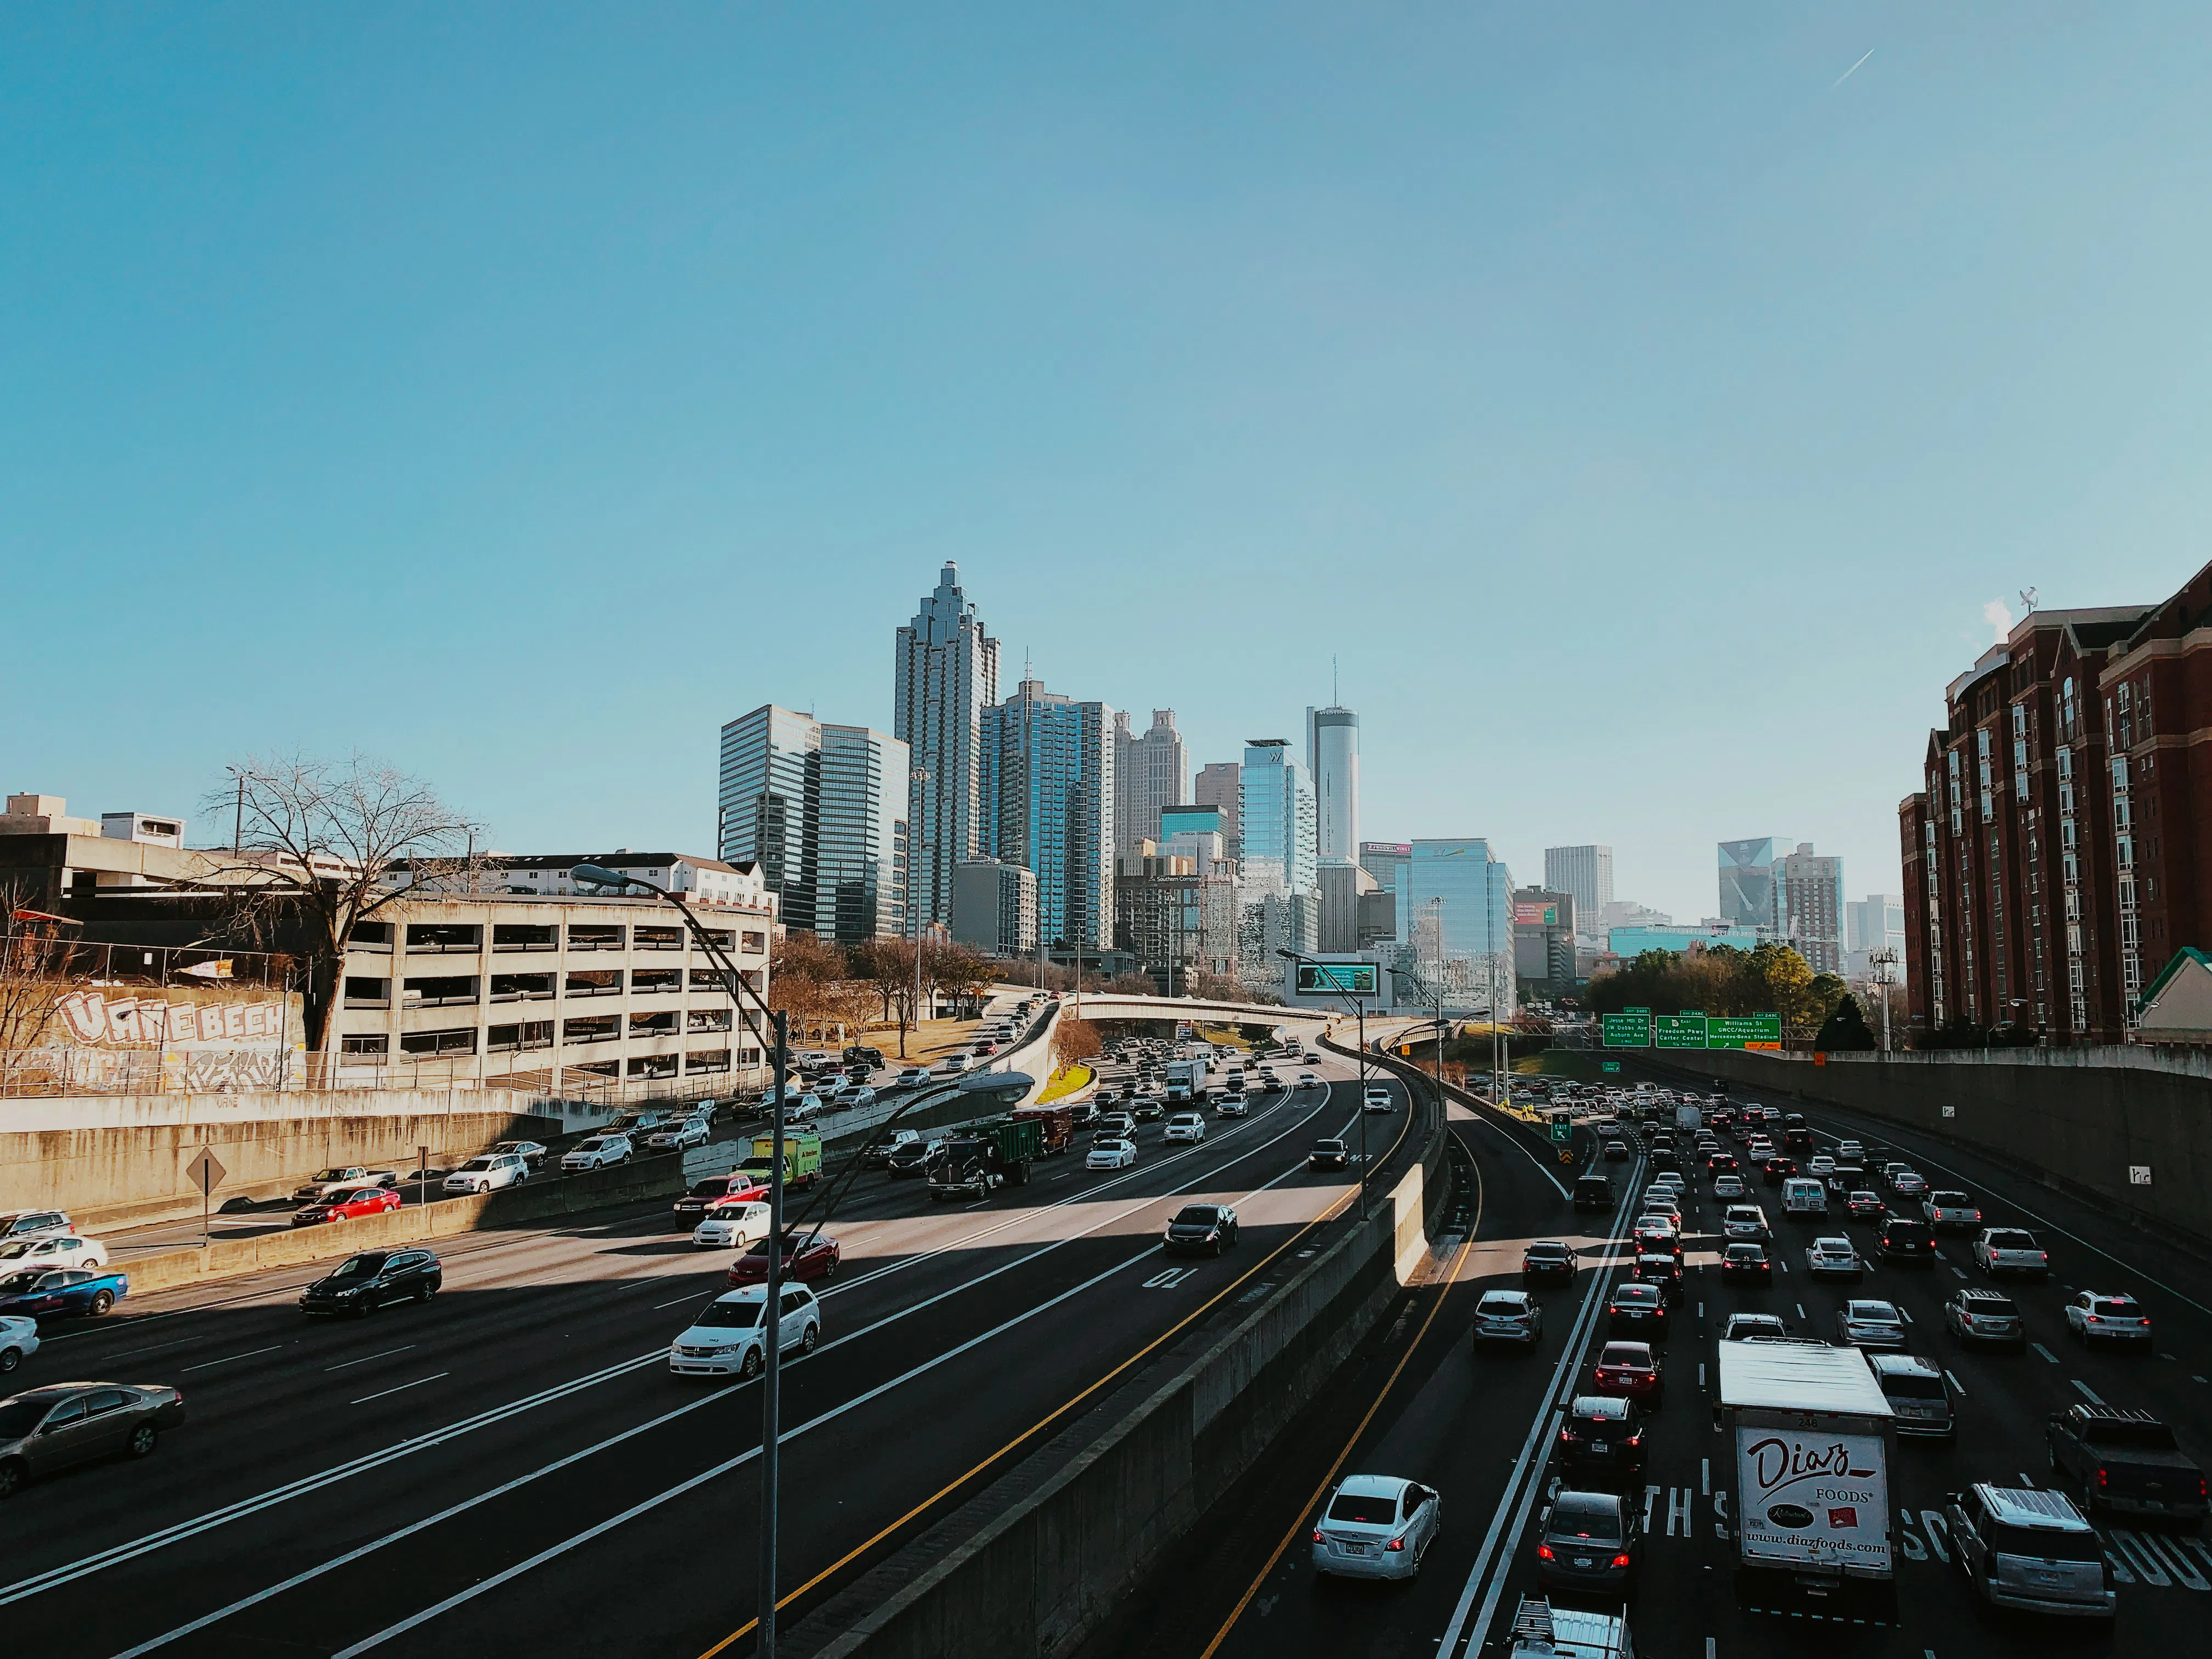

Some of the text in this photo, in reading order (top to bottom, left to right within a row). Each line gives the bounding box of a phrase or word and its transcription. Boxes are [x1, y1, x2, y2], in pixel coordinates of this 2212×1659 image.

[1798, 1417, 1819, 1428] 246
[1747, 1438, 1849, 1489] Diaz
[1816, 1488, 1869, 1503] FOODS
[1747, 1532, 1886, 1554] www.diazfoods.com
